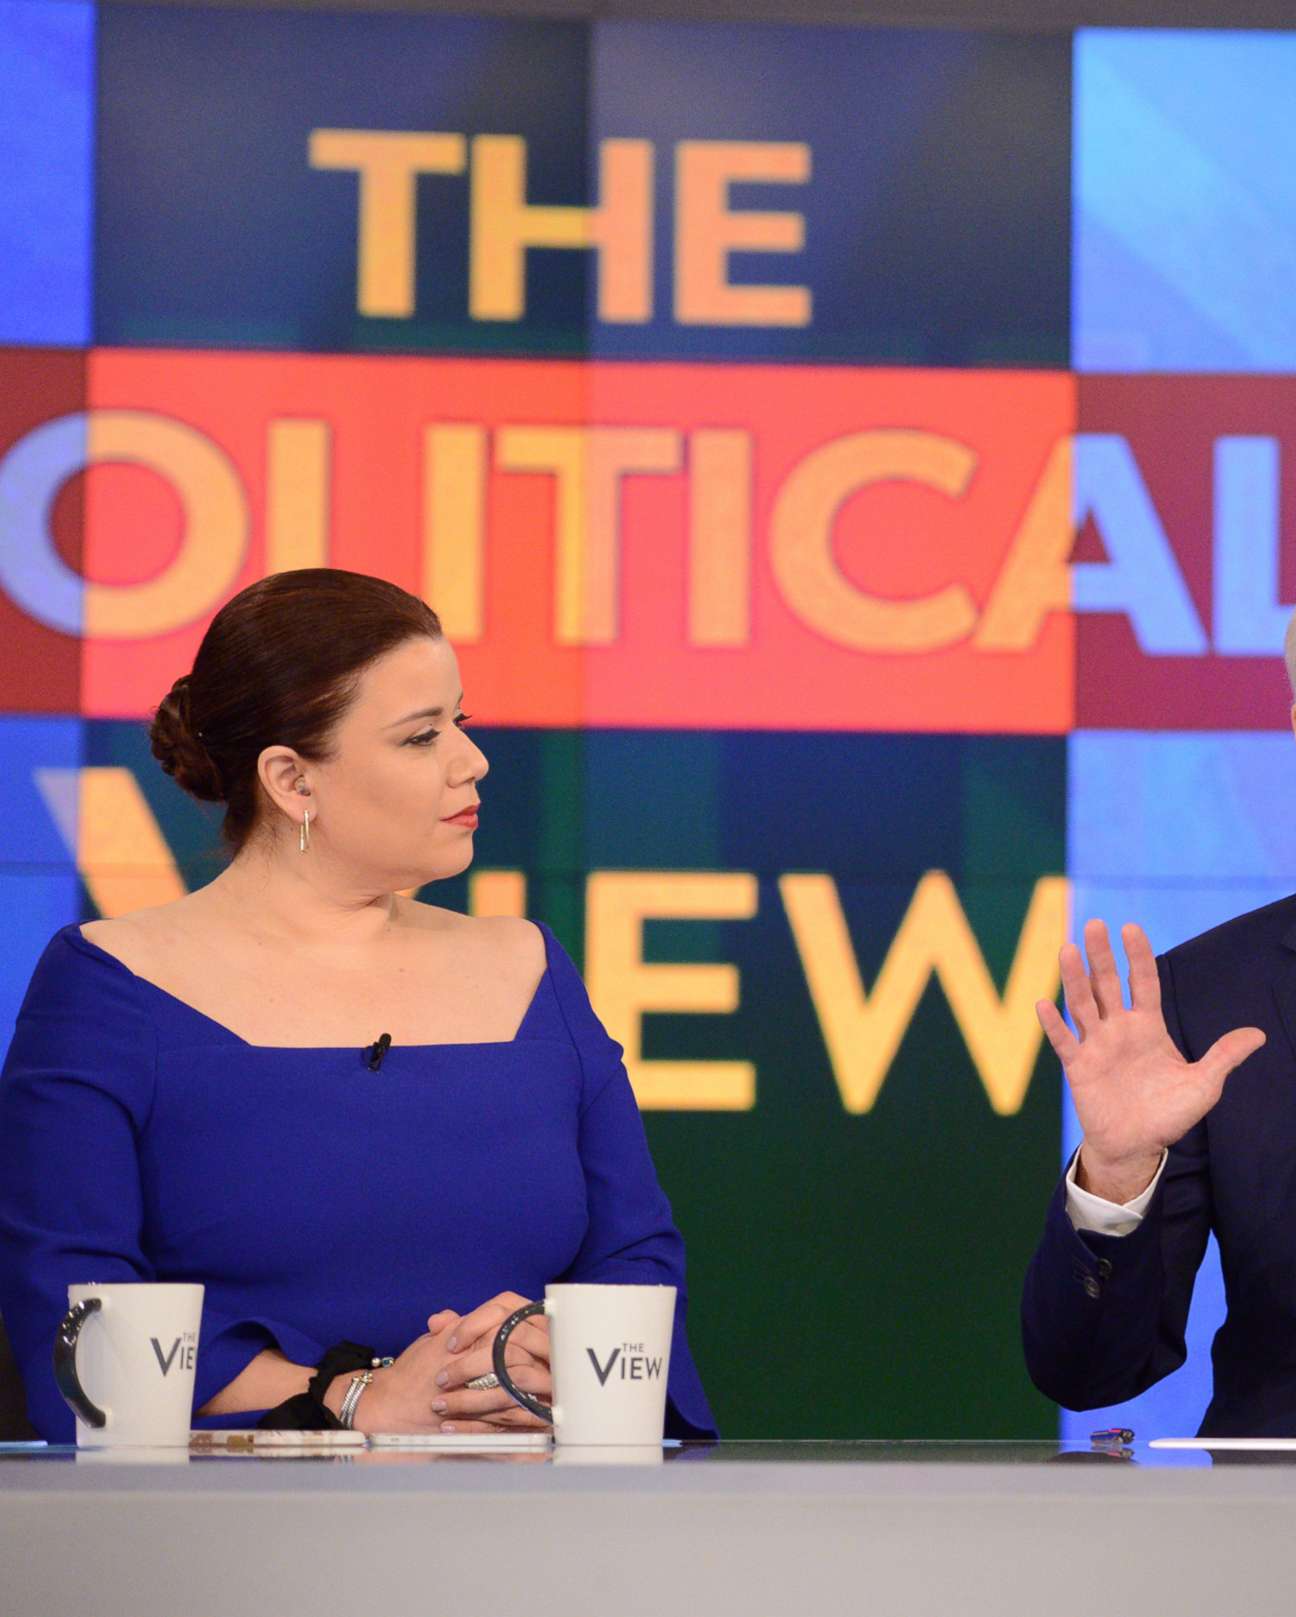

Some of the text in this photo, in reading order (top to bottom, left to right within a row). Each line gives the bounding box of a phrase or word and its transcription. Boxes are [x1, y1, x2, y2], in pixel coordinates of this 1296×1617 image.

[308, 128, 812, 327] THE
[35, 768, 1071, 1115] EW
[586, 1348, 663, 1388] VIEW
[622, 1343, 645, 1353] THE
